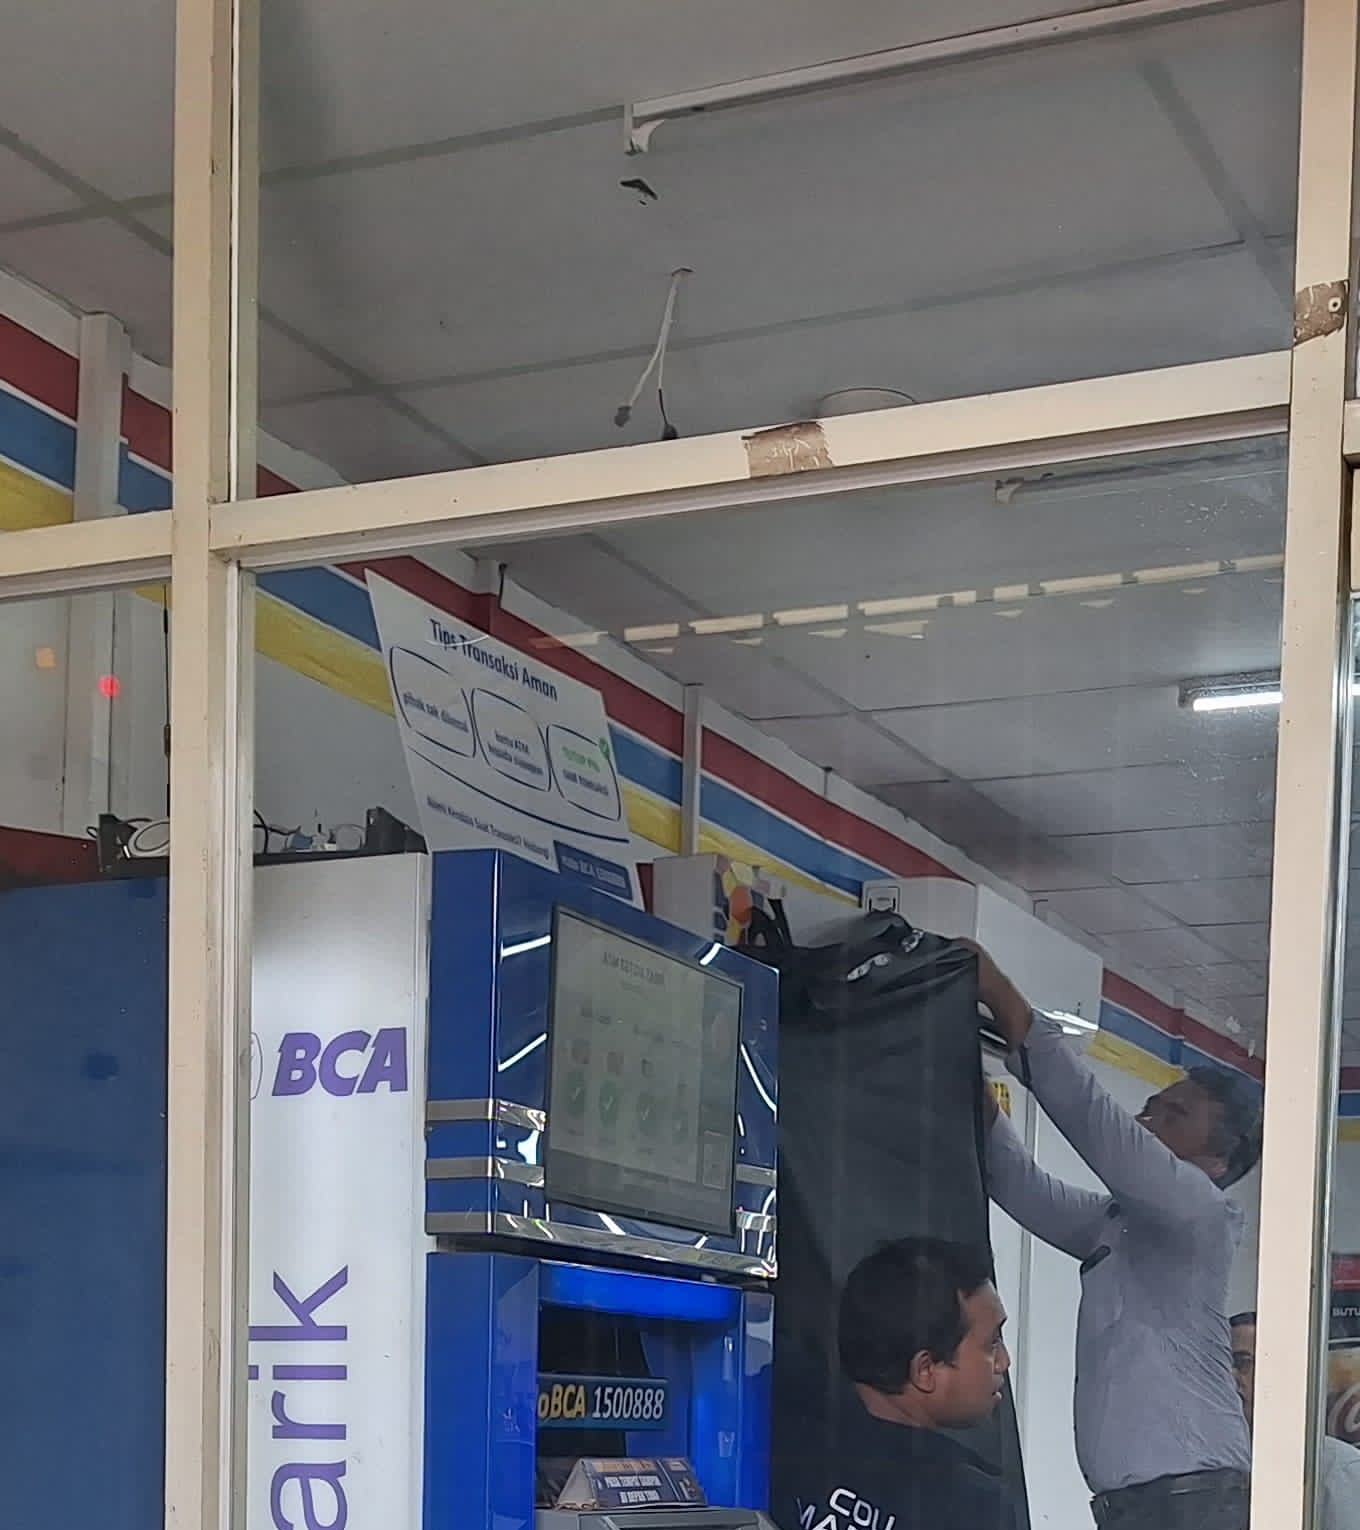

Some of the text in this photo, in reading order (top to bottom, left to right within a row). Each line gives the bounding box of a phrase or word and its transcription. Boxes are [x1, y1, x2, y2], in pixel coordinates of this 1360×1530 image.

[429, 618, 558, 701] Tips Transaksi Aman
[272, 1027, 408, 1096] BCA
[537, 1384, 665, 1419] oBCA 1500888
